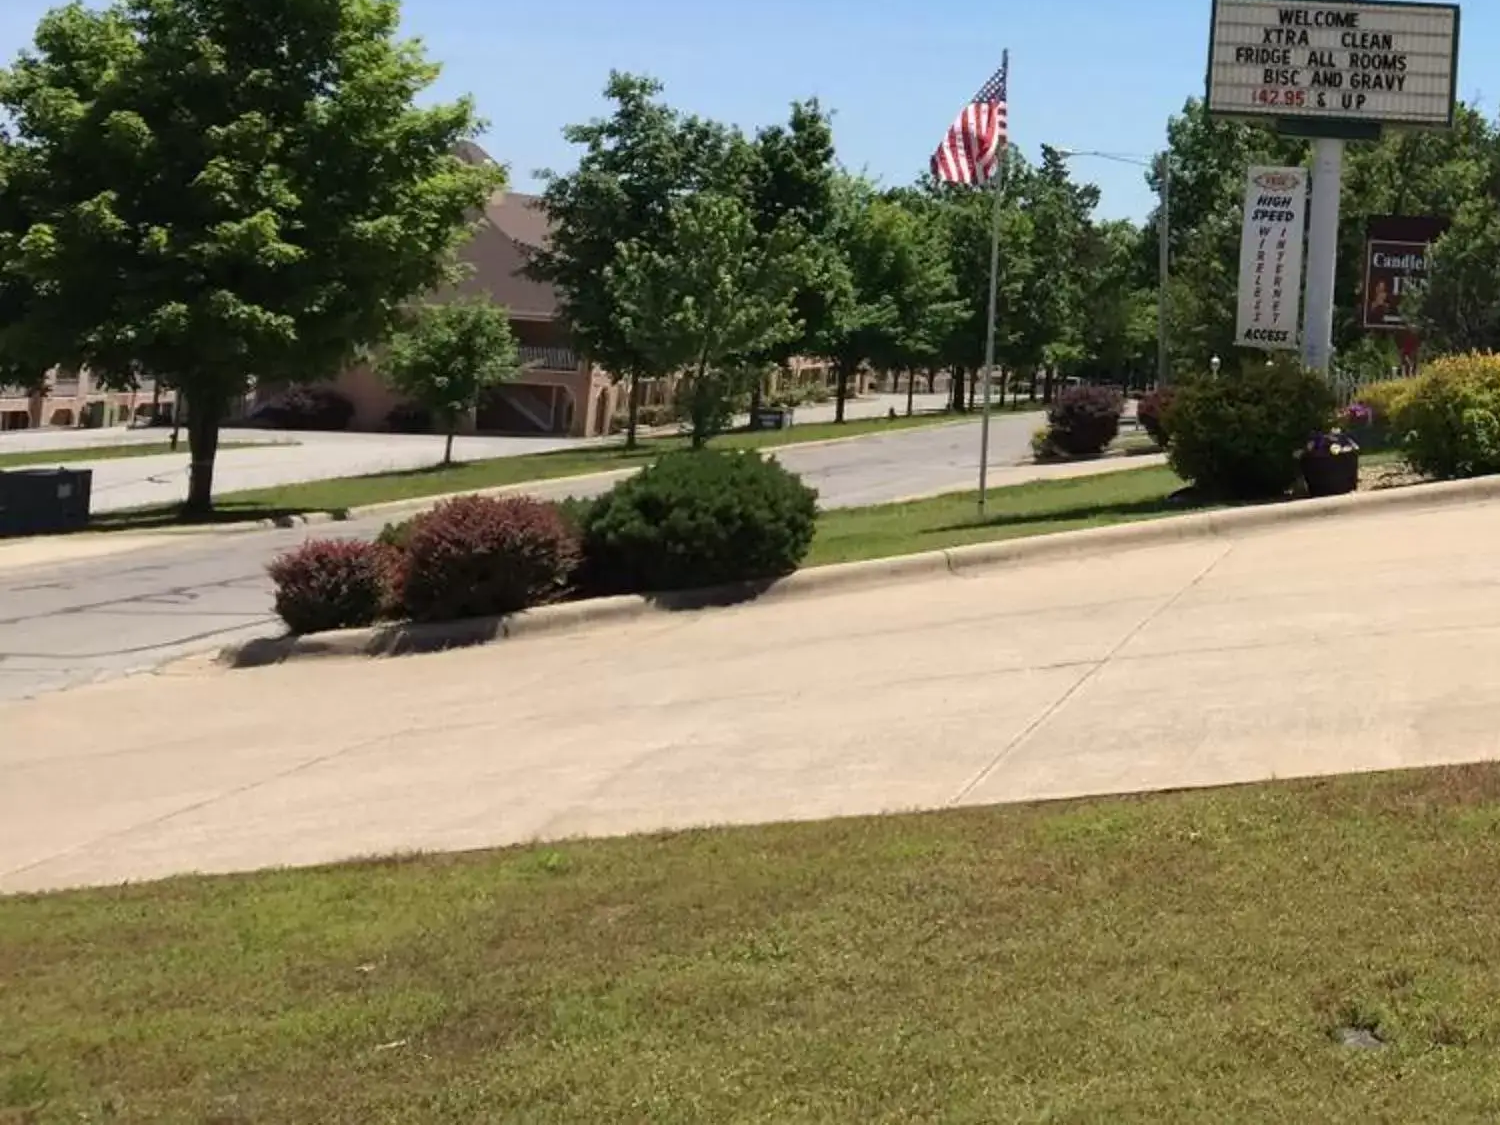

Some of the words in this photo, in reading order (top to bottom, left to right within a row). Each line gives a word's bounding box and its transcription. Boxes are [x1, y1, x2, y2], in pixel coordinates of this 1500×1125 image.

[1278, 9, 1360, 28] WELCOME
[1262, 29, 1310, 46] XTRA
[1341, 31, 1393, 50] CLEAN
[1235, 47, 1291, 64] FRIDGE
[1307, 51, 1336, 68] ALL
[1350, 53, 1408, 71] ROOMS
[1263, 68, 1299, 86] BISC
[1311, 70, 1343, 88] AND
[1350, 72, 1407, 92] GRAVY
[1317, 91, 1327, 108] &
[1341, 93, 1366, 110] UP
[1257, 195, 1293, 208] HIGH
[1252, 208, 1295, 223] SPEED
[1244, 328, 1290, 343] ACCESS
